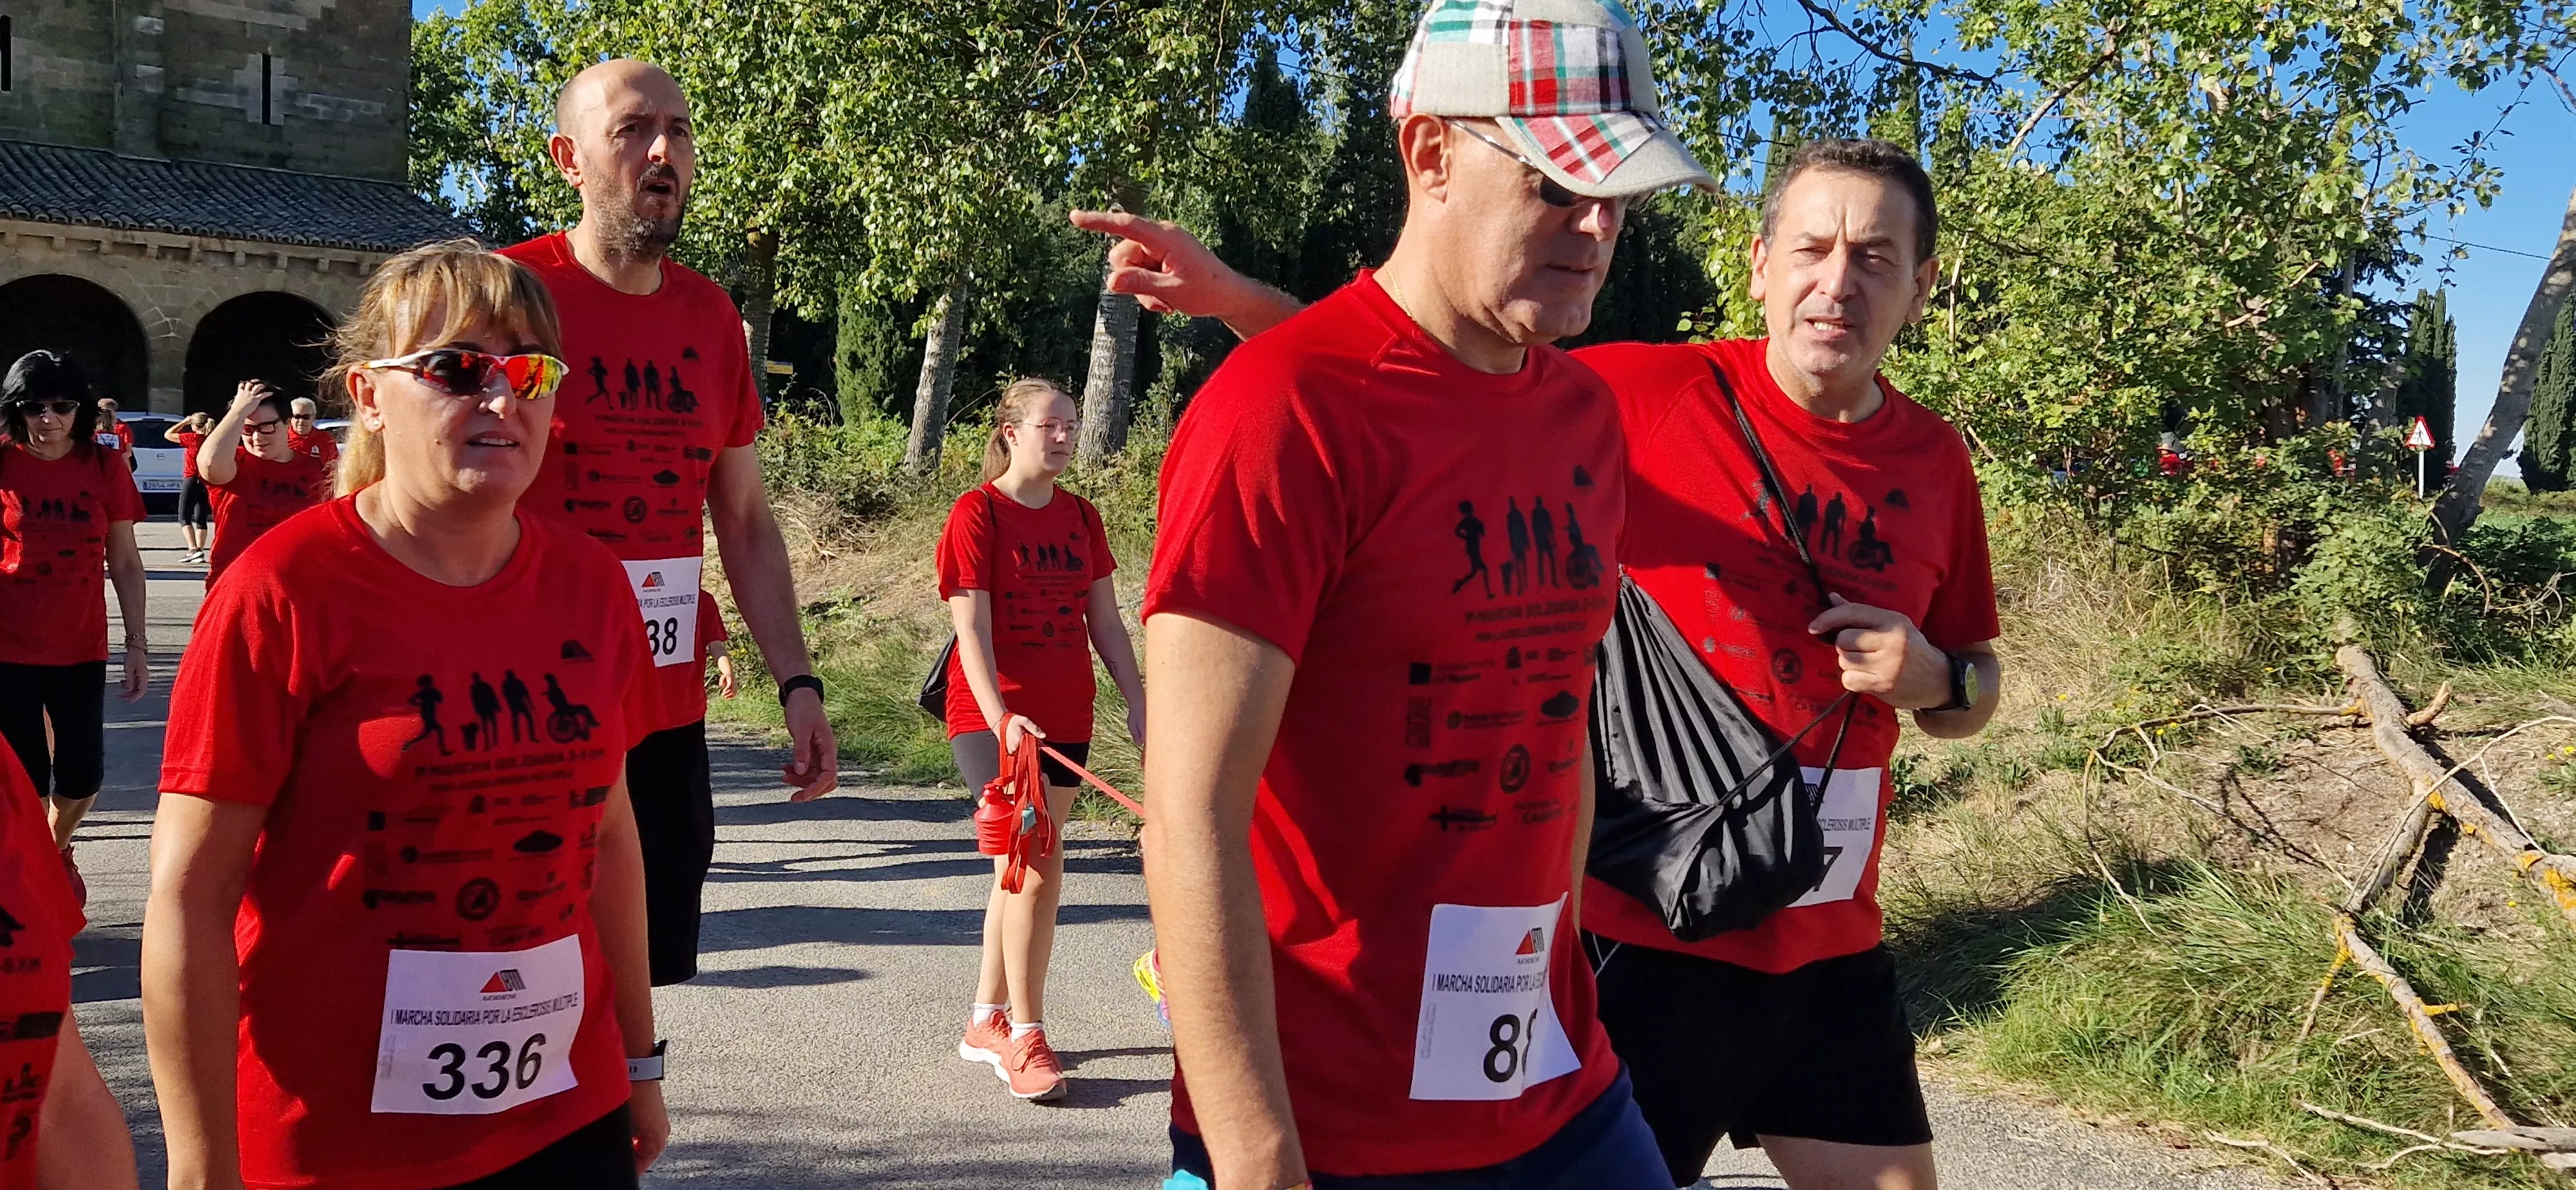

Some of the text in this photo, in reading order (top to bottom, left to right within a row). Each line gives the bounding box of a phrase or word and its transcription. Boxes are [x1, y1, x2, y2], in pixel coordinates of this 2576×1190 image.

[645, 617, 678, 656] 38
[1437, 973, 1473, 992] MARCHA
[1474, 974, 1514, 993] SOLIDARIA
[1515, 974, 1530, 992] POR
[395, 1009, 433, 1025] MARCHA
[434, 1010, 481, 1026] SOLIDARIA
[482, 1009, 500, 1025] POR
[422, 1033, 547, 1100] 336
